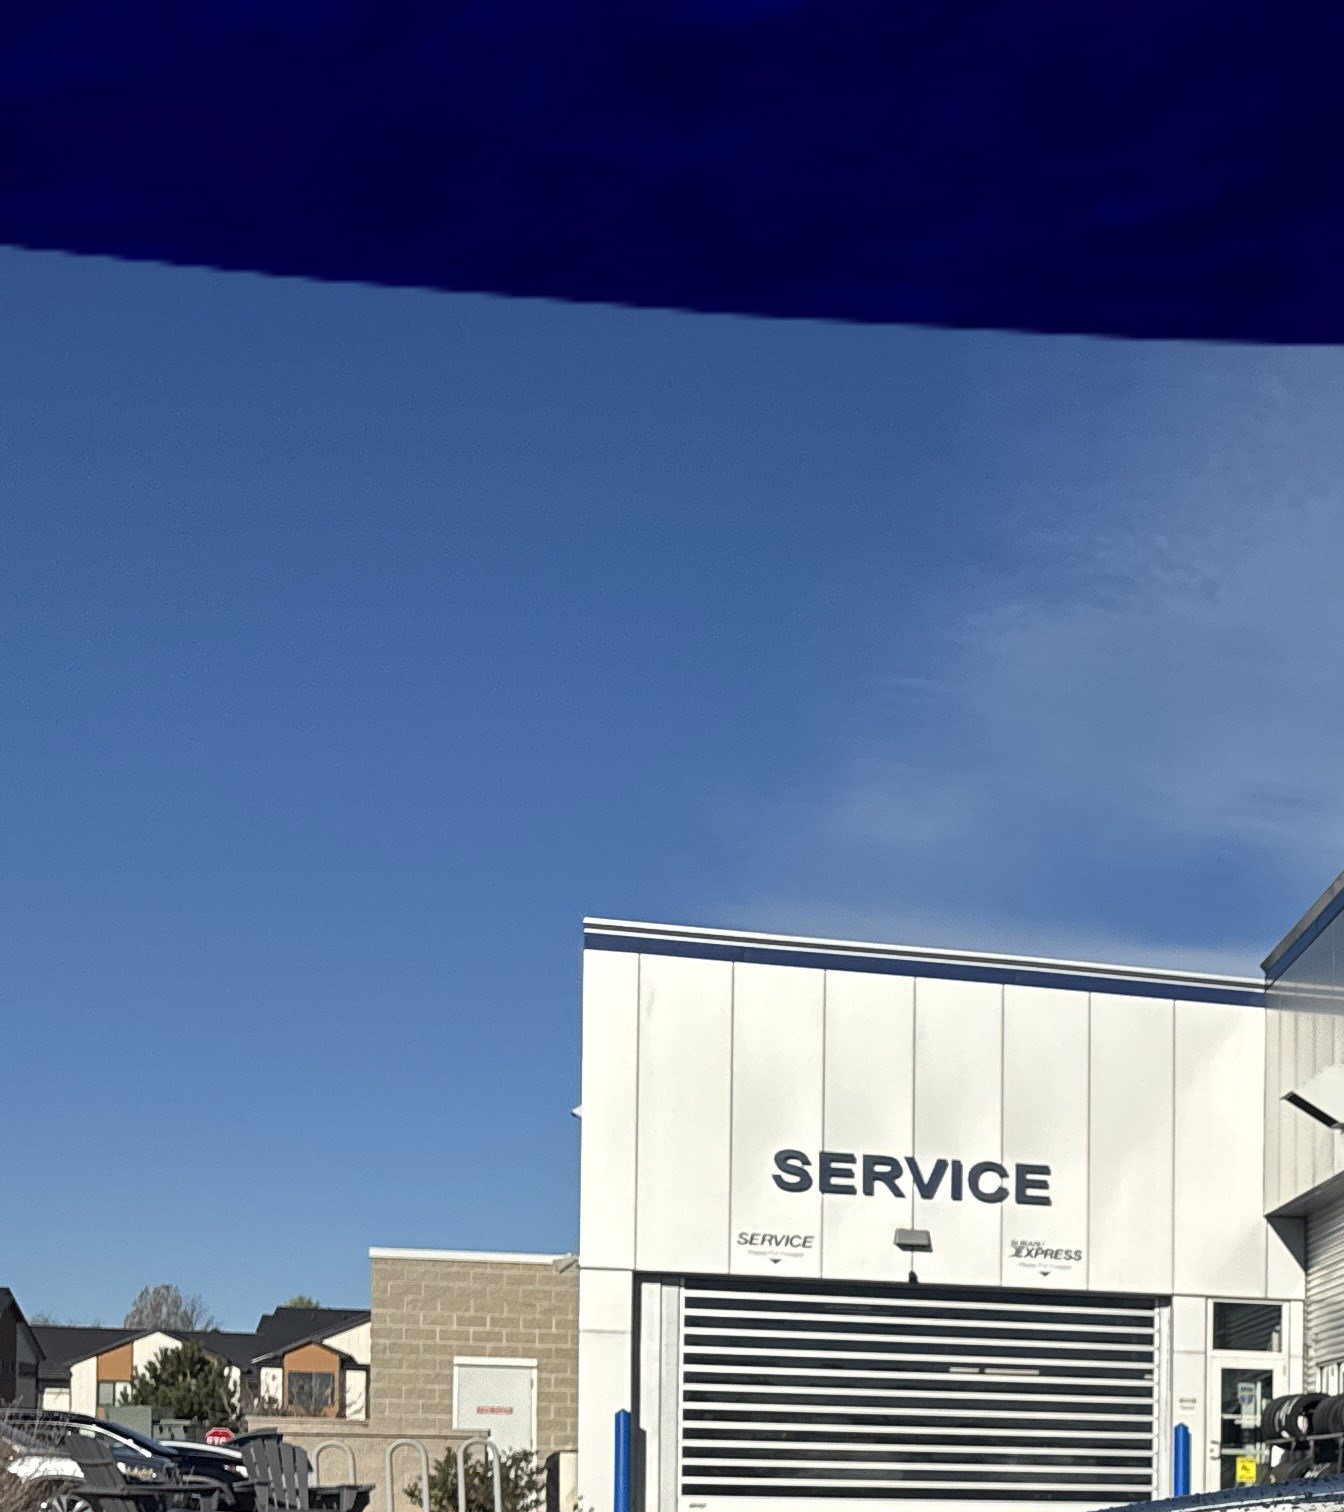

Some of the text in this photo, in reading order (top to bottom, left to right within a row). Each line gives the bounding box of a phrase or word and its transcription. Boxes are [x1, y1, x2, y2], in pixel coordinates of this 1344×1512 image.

[771, 1148, 1052, 1207] SERVICE
[737, 1231, 814, 1249] SERVICE
[1010, 1246, 1083, 1261] EXPRESS
